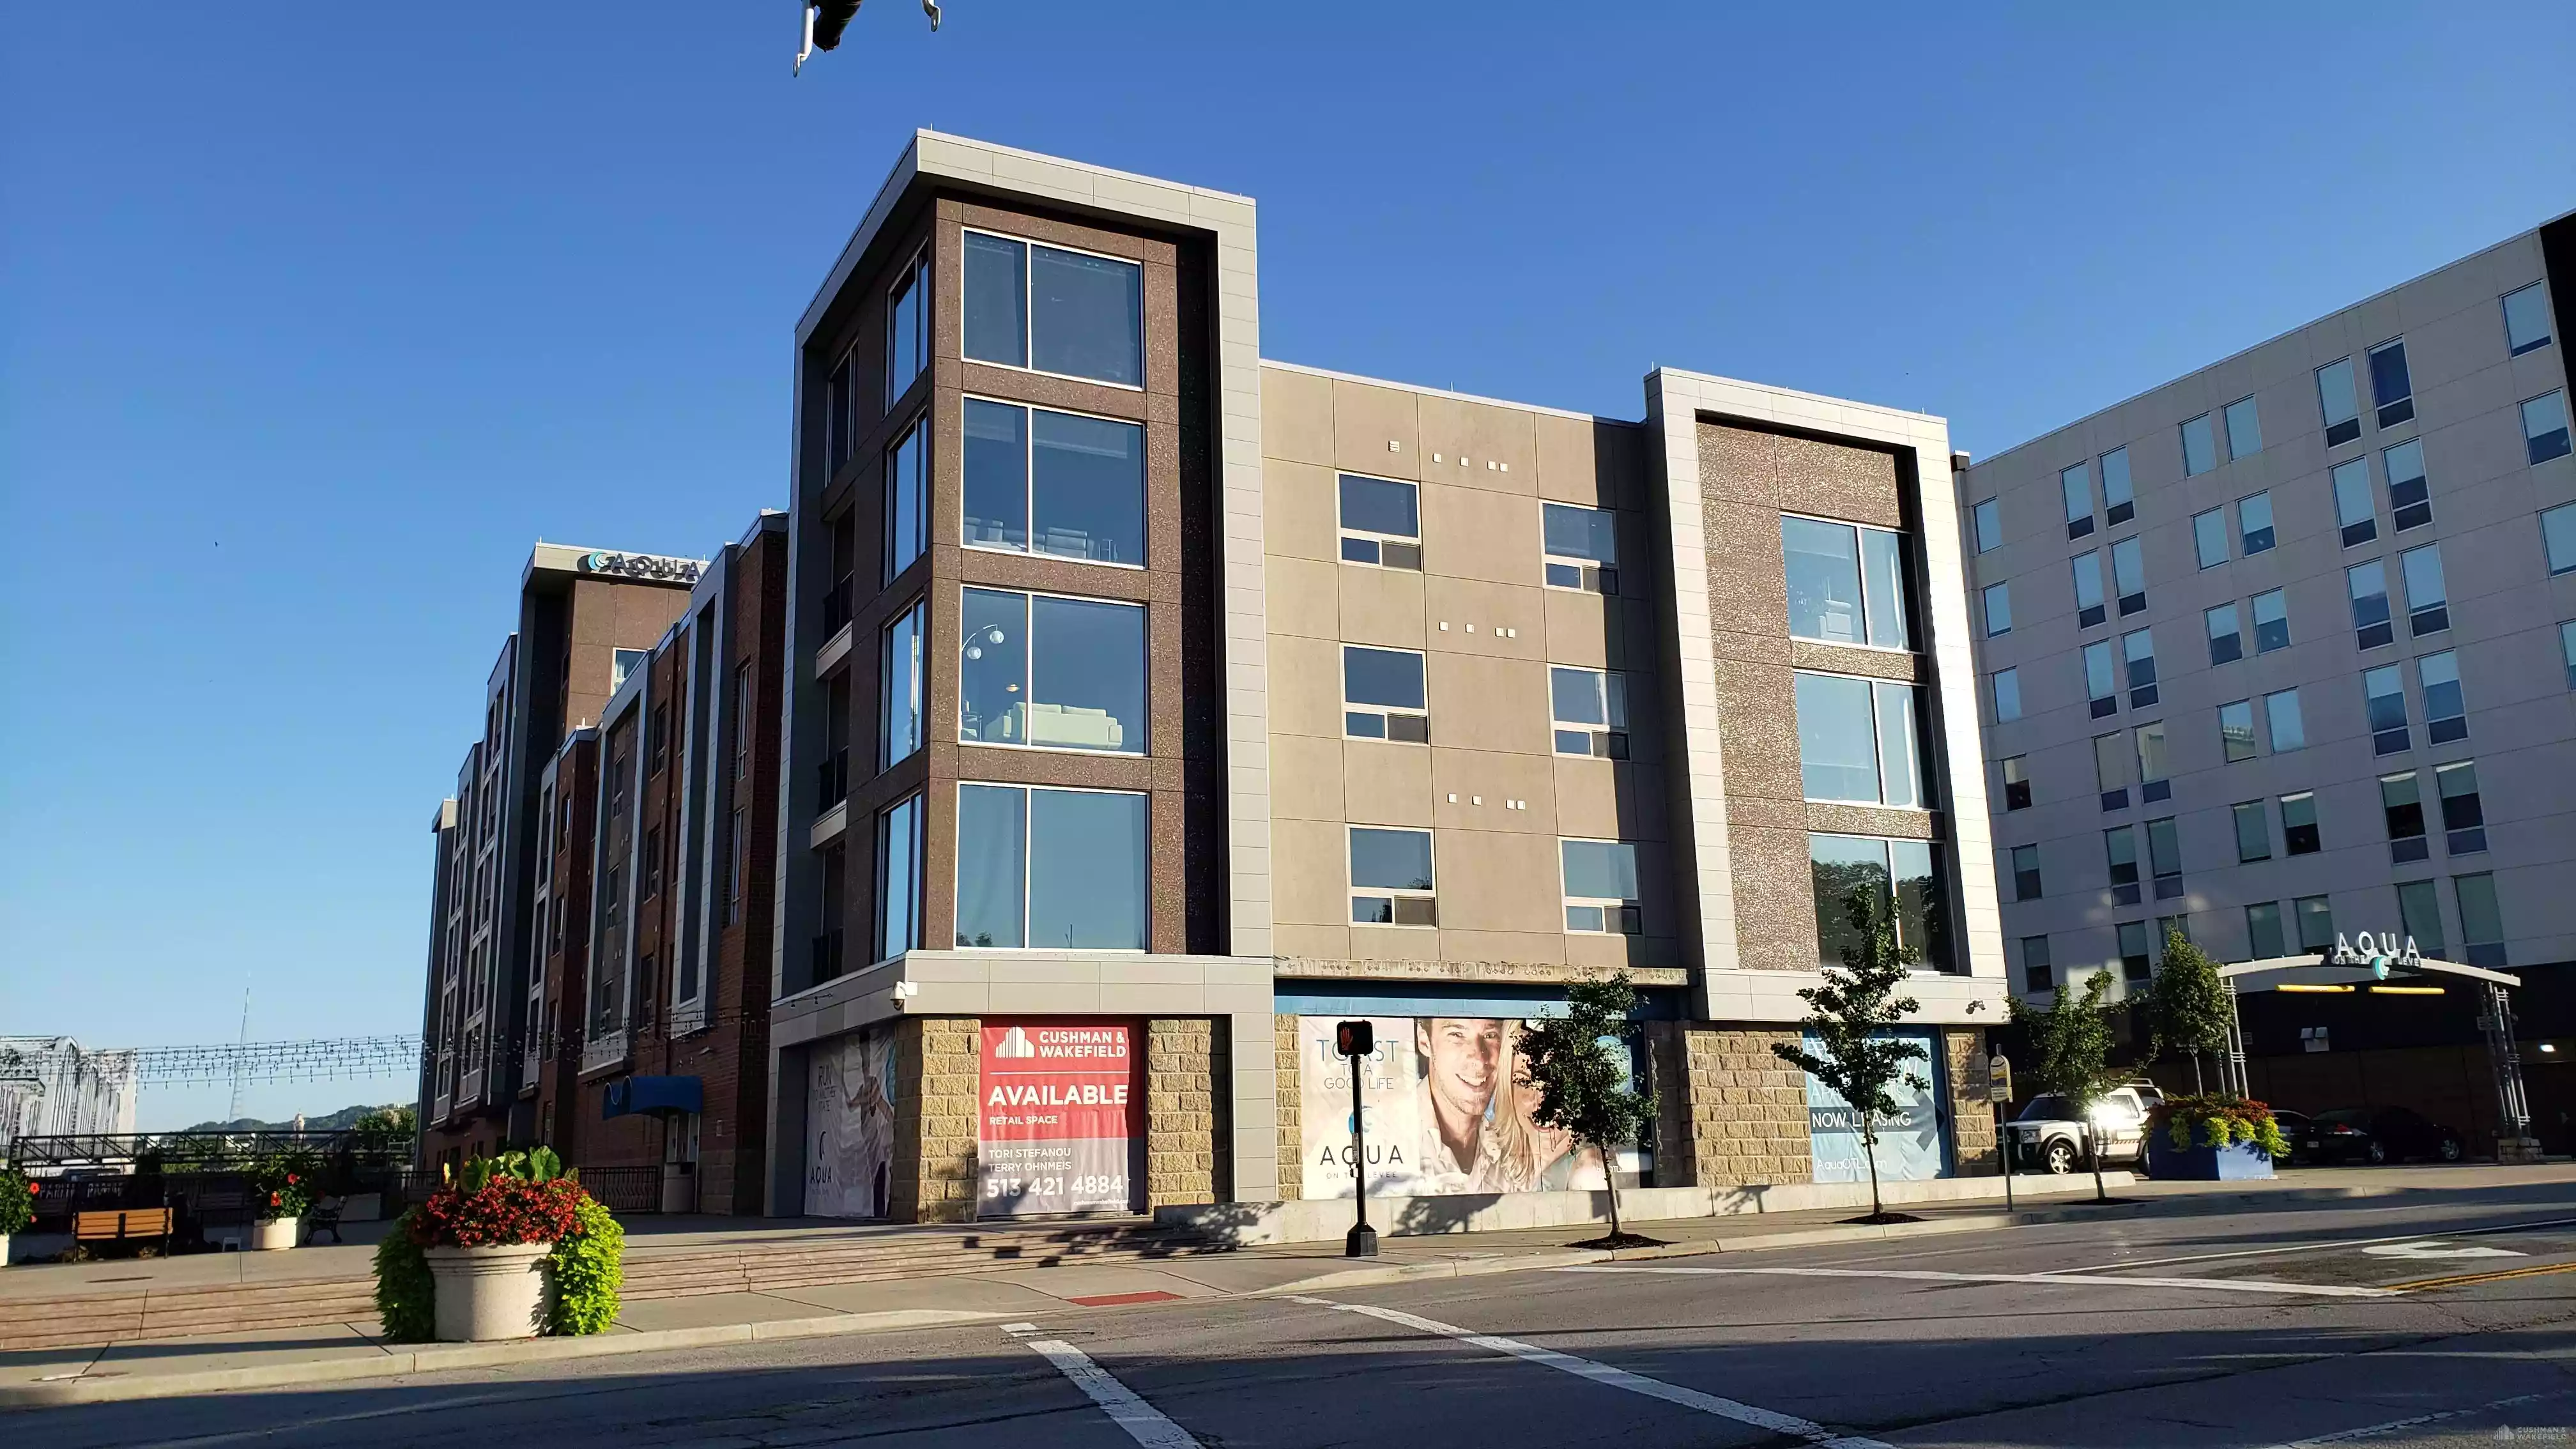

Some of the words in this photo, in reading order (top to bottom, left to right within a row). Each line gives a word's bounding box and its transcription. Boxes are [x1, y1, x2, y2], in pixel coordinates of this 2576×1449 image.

[611, 553, 701, 578] AQUA
[2338, 931, 2420, 959] AQUA
[1039, 1031, 1112, 1043] CUSHMAN
[1116, 1031, 1126, 1043] &
[1039, 1045, 1126, 1058] WAKEFIELD
[1316, 1039, 1399, 1062] TOST
[1363, 1063, 1373, 1075] A
[1368, 1077, 1394, 1089] LIFE
[988, 1084, 1129, 1107] AVAILABLE
[990, 1116, 1023, 1125] RETAIL
[1025, 1115, 1058, 1124] SPACE
[1812, 1112, 1846, 1128] NOW
[988, 1149, 1013, 1158] TORI
[1016, 1147, 1071, 1158] STEFANOU
[1320, 1145, 1404, 1167] AQUA
[988, 1163, 1022, 1172] TERRY
[1024, 1161, 1072, 1171] OHNMEIS
[810, 1165, 832, 1186] AQUA
[986, 1178, 1021, 1197] 513
[1029, 1176, 1064, 1196] 421
[1071, 1176, 1123, 1194] 4884
